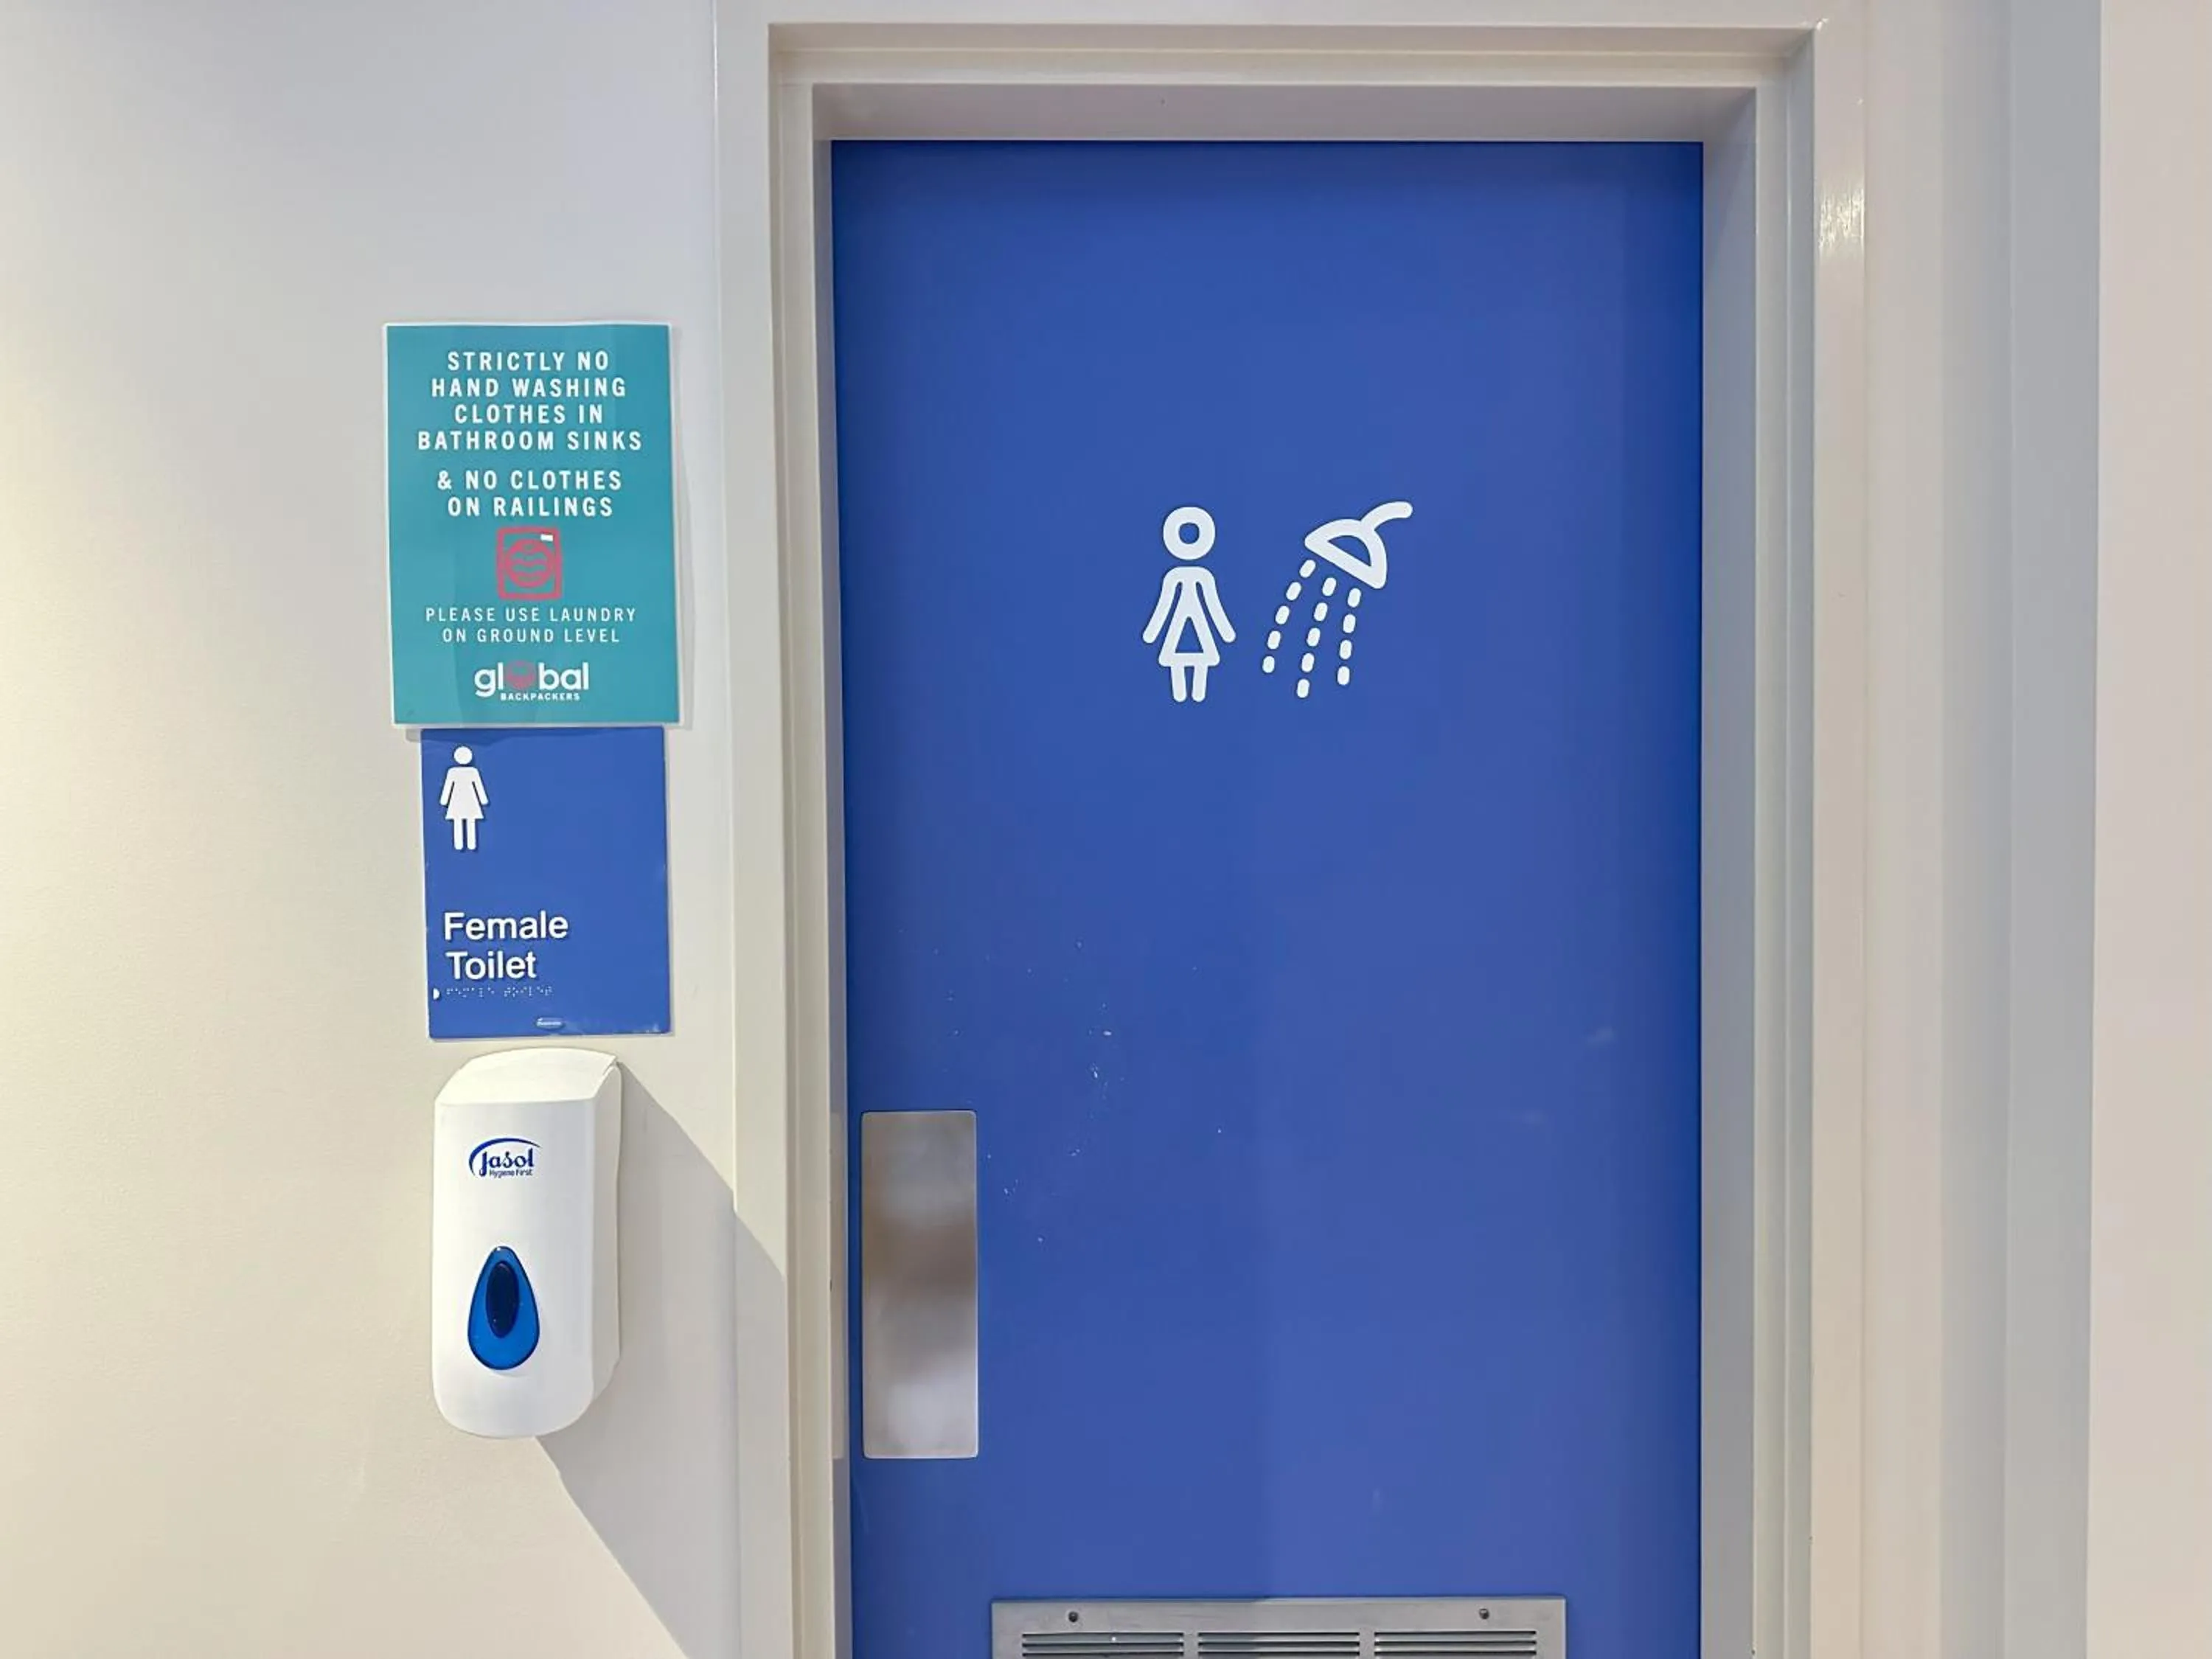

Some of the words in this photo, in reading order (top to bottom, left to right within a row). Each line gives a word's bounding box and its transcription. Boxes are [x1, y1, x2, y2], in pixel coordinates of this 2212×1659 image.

[447, 352, 566, 371] STRICTLY
[577, 351, 609, 370] NO
[431, 378, 499, 397] HAND
[512, 378, 626, 397] WASHING
[454, 405, 566, 423] CLOTHES
[579, 405, 602, 422] IN
[418, 431, 554, 450] BATHROOM
[568, 431, 642, 450] SINKS
[437, 472, 452, 490] &
[465, 471, 497, 490] NO
[510, 470, 622, 490] CLOTHES
[448, 498, 479, 516] ON
[493, 497, 613, 516] RAILINGS
[425, 608, 495, 622] PLEASE
[506, 608, 539, 622] USE
[549, 608, 636, 622] LAUNDRY
[443, 629, 466, 642] ON
[477, 629, 554, 642] GROUND
[565, 629, 620, 642] LEVEL
[501, 692, 580, 700] BACKPACKERS
[444, 911, 568, 940] Female
[445, 950, 537, 979] Toilet
[479, 1148, 535, 1177] Jasol
